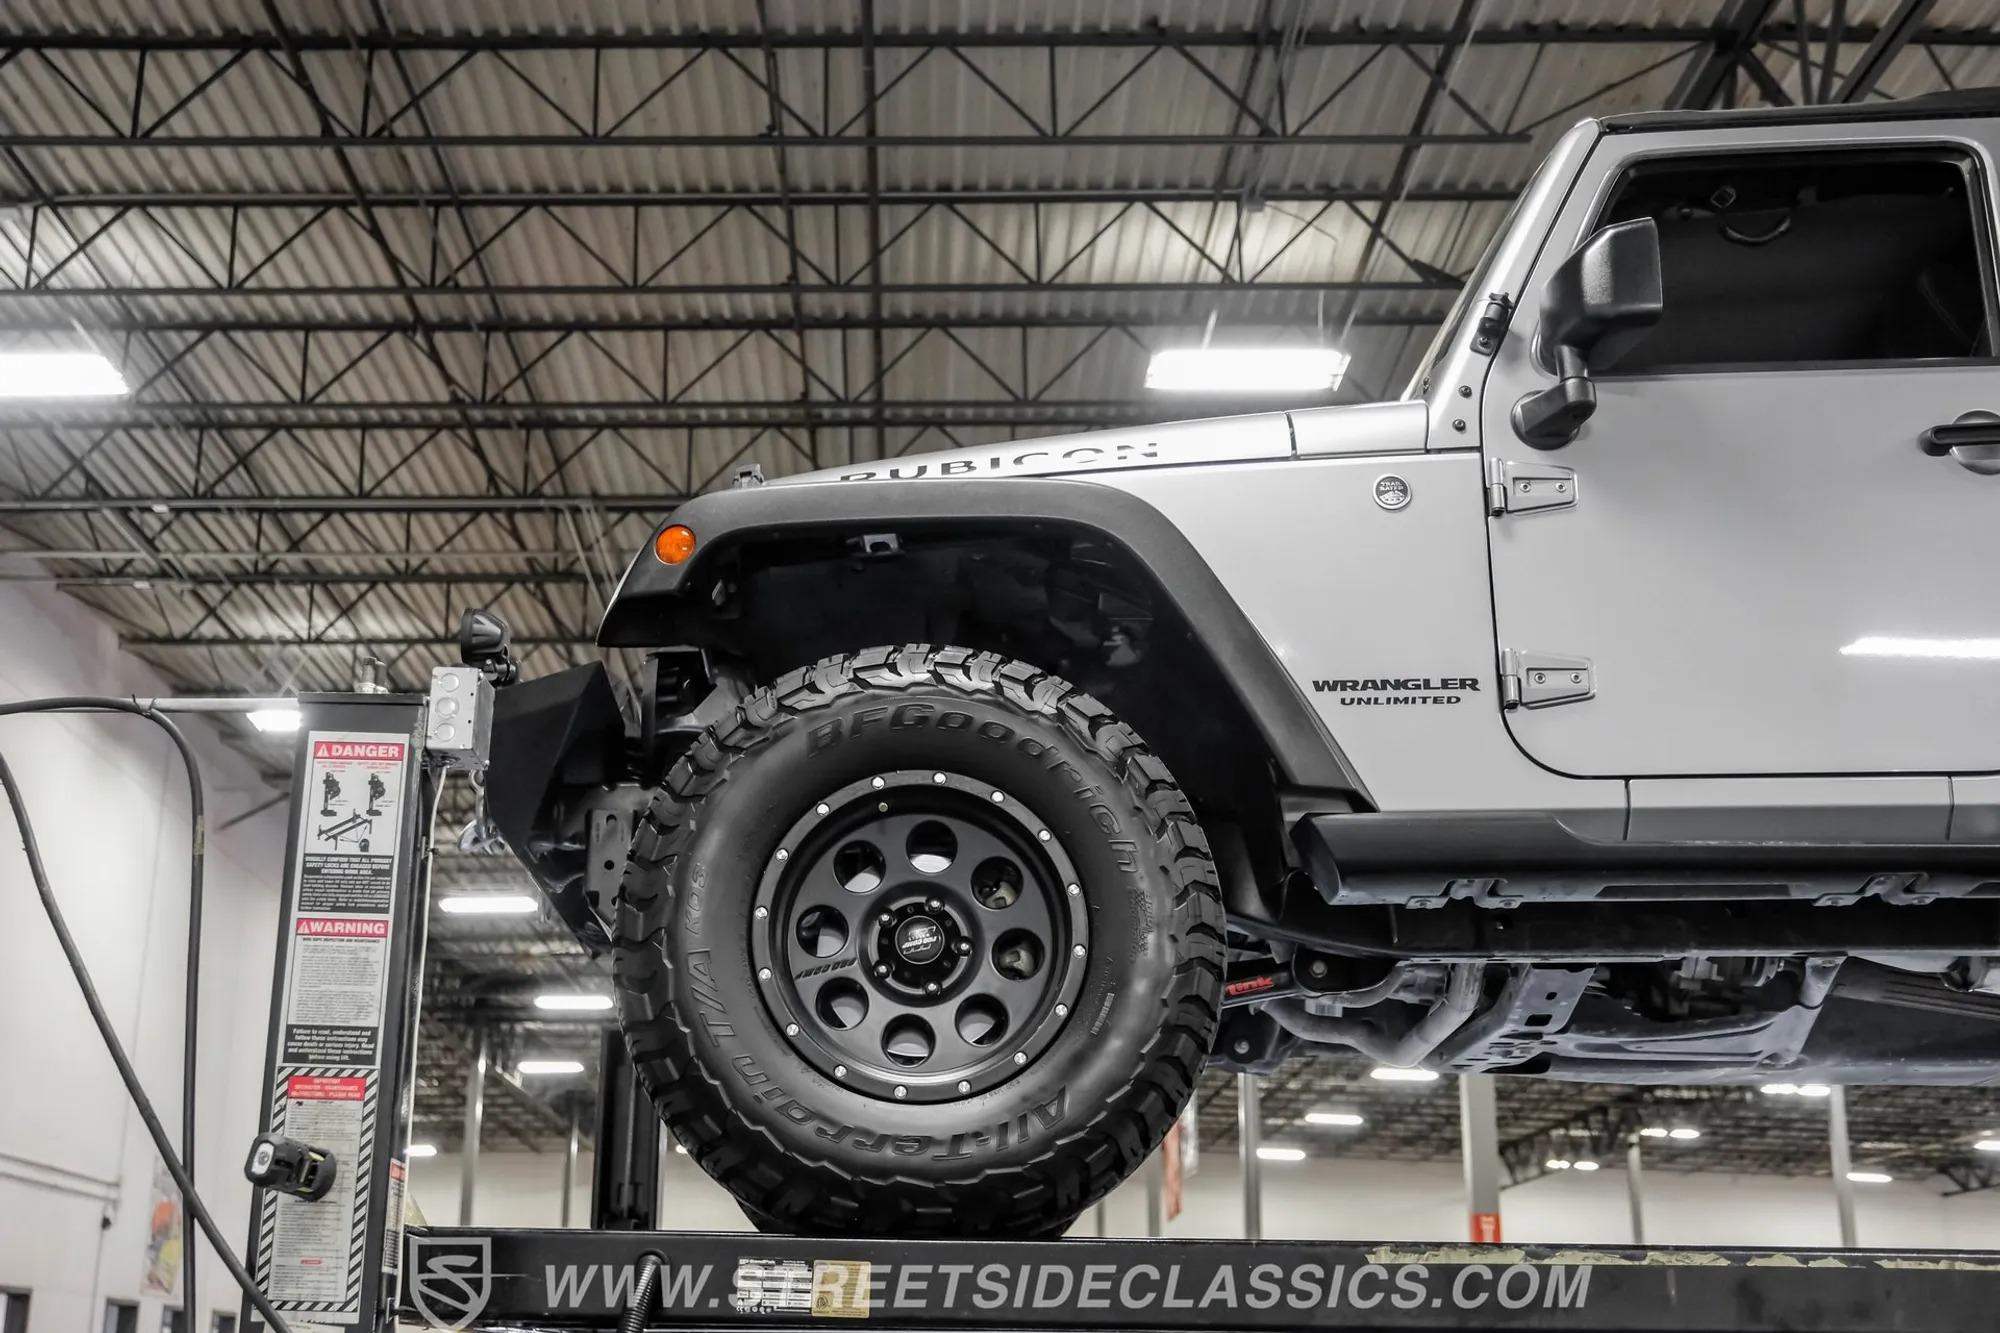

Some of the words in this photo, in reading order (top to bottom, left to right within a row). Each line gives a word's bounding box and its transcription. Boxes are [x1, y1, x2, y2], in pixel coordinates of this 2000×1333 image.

[1312, 678, 1481, 692] WRANGLER
[1340, 696, 1461, 706] UNLIMITED
[331, 745, 399, 758] DANGER
[807, 703, 1138, 873] BFGoodrich
[310, 921, 385, 934] WARNING
[687, 948, 736, 1048] T/A
[732, 1055, 1067, 1161] All-Terrain
